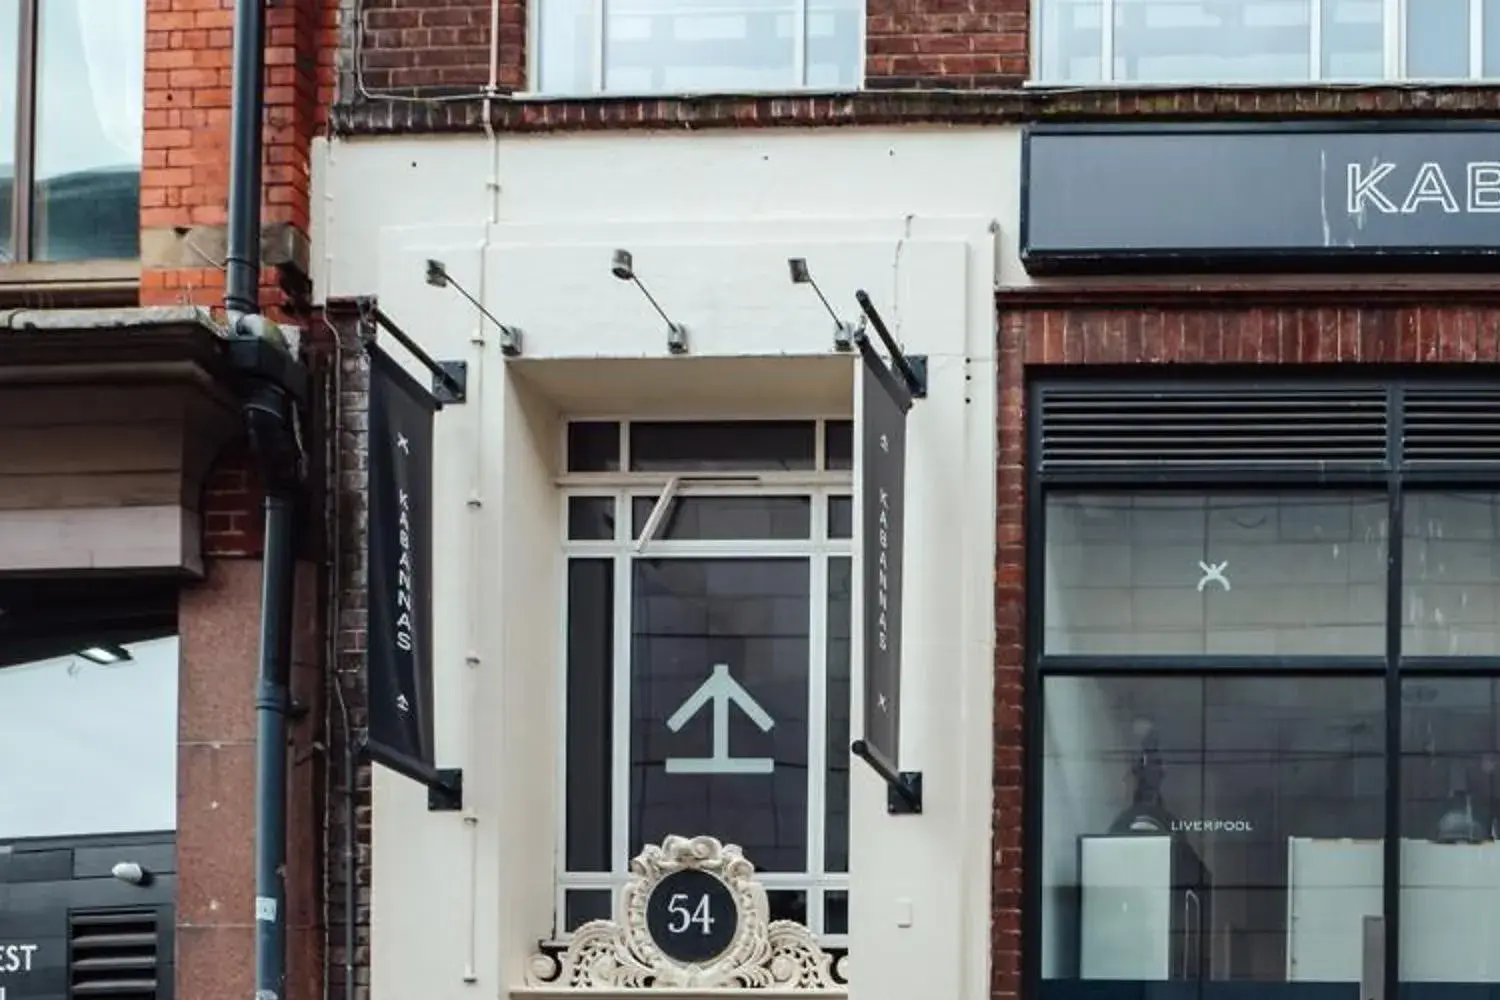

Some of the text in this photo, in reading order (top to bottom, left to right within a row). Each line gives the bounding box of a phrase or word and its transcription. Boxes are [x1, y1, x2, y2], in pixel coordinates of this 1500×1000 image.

[396, 487, 412, 651] KABANNAS
[1170, 820, 1254, 832] LIVERPOOL
[667, 893, 716, 935] 54
